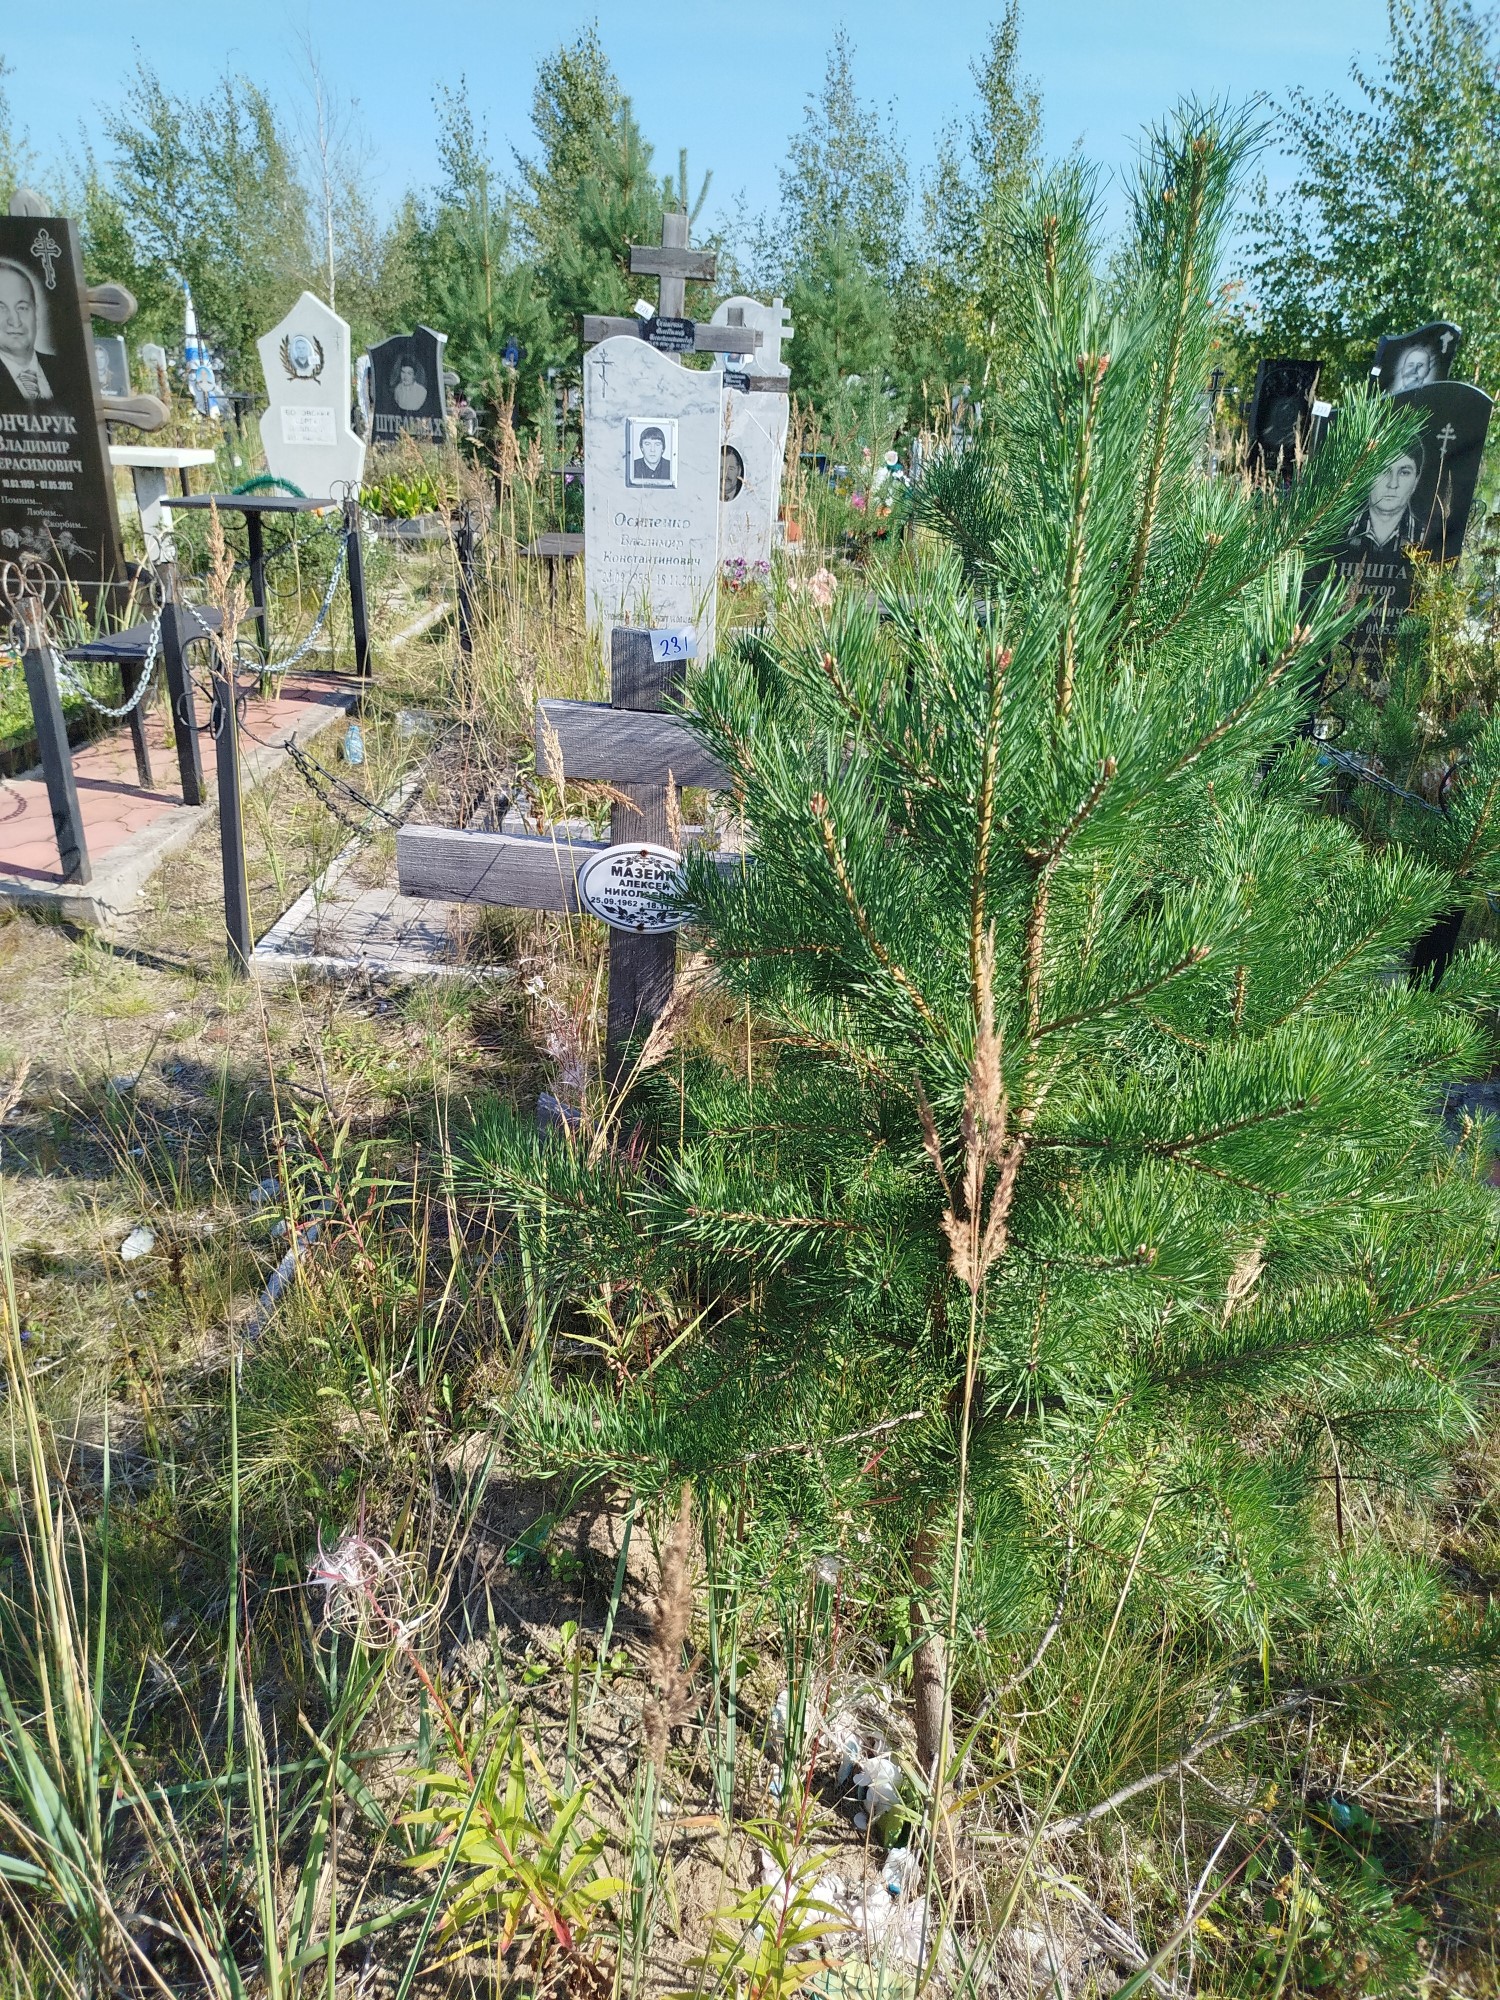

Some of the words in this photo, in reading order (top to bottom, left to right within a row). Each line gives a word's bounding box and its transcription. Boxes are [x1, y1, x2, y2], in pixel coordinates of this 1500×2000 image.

[0, 414, 78, 434] НЧАРУК
[614, 512, 691, 529] Осипенко
[1354, 583, 1396, 596] иктор
[660, 636, 687, 656] 231
[618, 879, 670, 891] АЛЕКСЕЙ
[590, 896, 638, 907] 25.09.1962
